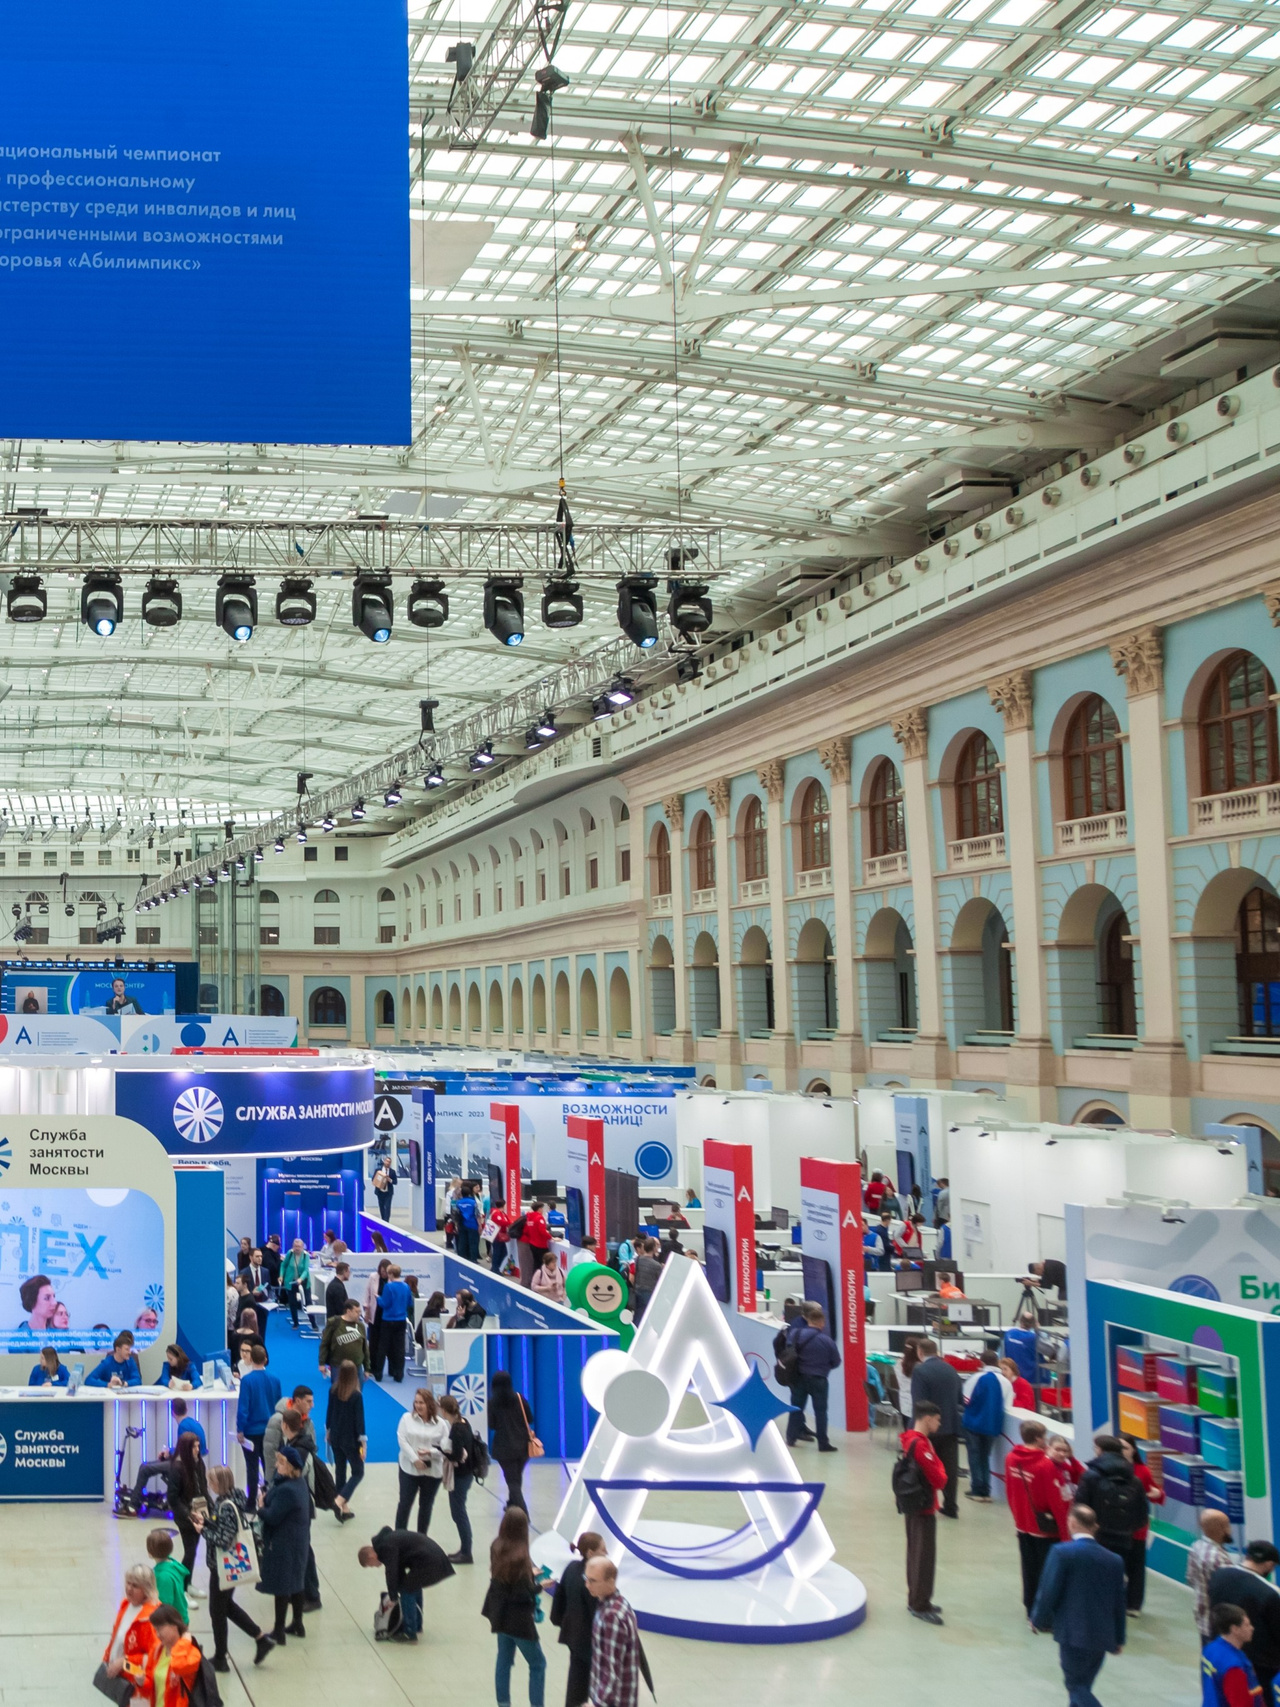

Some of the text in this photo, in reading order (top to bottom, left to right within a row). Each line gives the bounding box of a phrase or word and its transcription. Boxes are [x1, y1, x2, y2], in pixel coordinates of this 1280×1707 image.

[123, 149, 221, 162] чемпионат
[7, 170, 195, 193] профессиональному
[85, 202, 138, 218] среди
[145, 204, 241, 219] инвалидов
[247, 206, 258, 217] и
[263, 207, 296, 221] лиц
[143, 231, 283, 245] возможностями
[68, 251, 201, 271] «Абилимпикс»
[235, 1102, 355, 1121] СЛУЖБА ЗАНЯТОСТИ
[562, 1103, 668, 1115] ВОЗМОЖНОСТИ
[29, 1128, 87, 1144] Служба
[29, 1148, 104, 1158] занятости
[29, 1163, 89, 1175] Москвы
[47, 1340, 94, 1348] эффективная
[14, 1429, 65, 1443] Служба
[14, 1444, 79, 1454] занятости
[14, 1457, 65, 1468] Москвы
